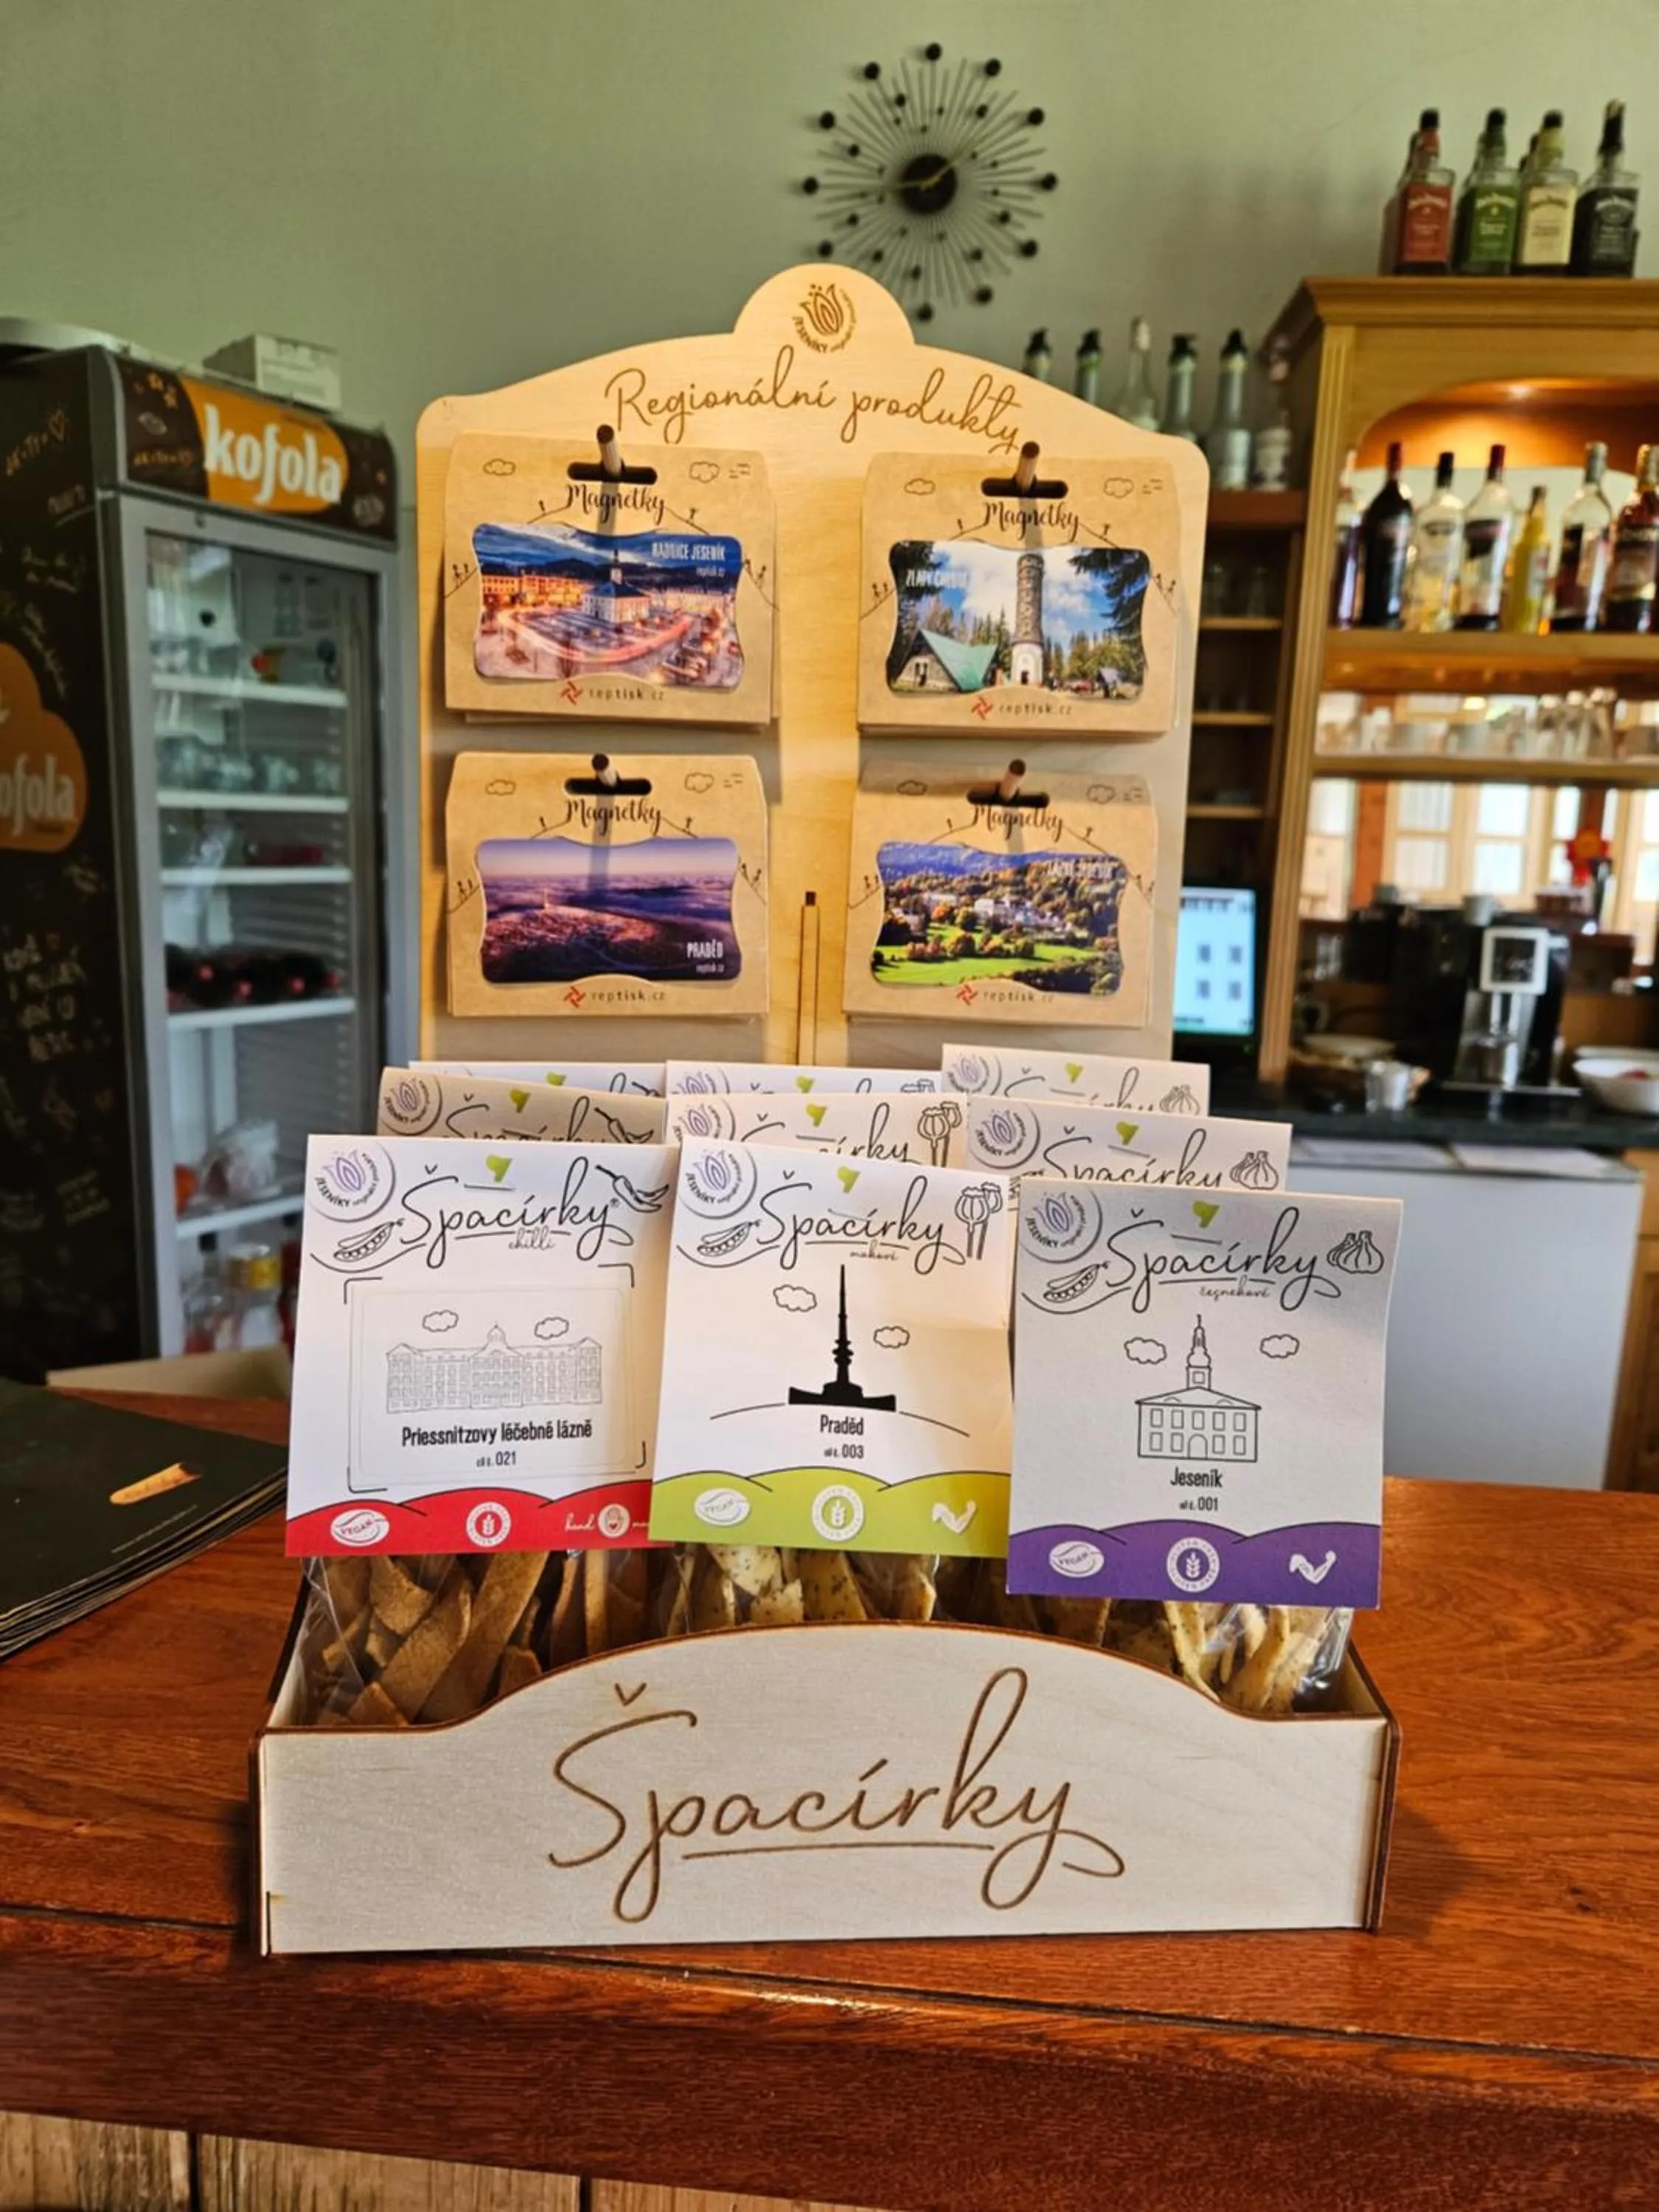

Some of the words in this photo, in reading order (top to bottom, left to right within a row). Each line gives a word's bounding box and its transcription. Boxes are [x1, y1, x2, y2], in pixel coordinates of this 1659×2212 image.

[605, 344, 837, 445] Regionální
[840, 366, 1022, 456] produkty
[204, 403, 341, 506] kofola
[566, 484, 665, 522] Magnetky
[982, 502, 1081, 542] Magnetky
[566, 799, 662, 836] Magnetky
[972, 806, 1065, 842] Magnetky
[400, 1155, 633, 1269] Špacírky
[757, 1175, 967, 1276] Špacírky
[1105, 1206, 1342, 1314] Špacírky
[402, 1423, 497, 1447] Priessnitzovy
[500, 1419, 554, 1442] léčebné
[556, 1418, 593, 1440] lázně
[820, 1413, 864, 1436] Praděd
[495, 1450, 517, 1466] 021
[842, 1444, 864, 1459] 003
[1169, 1466, 1223, 1488] Jeseník
[1198, 1496, 1219, 1512] 001
[341, 1518, 374, 1535] VEGAN
[1059, 1551, 1089, 1565] VEGAN
[549, 1667, 1125, 1923] Špacírky
